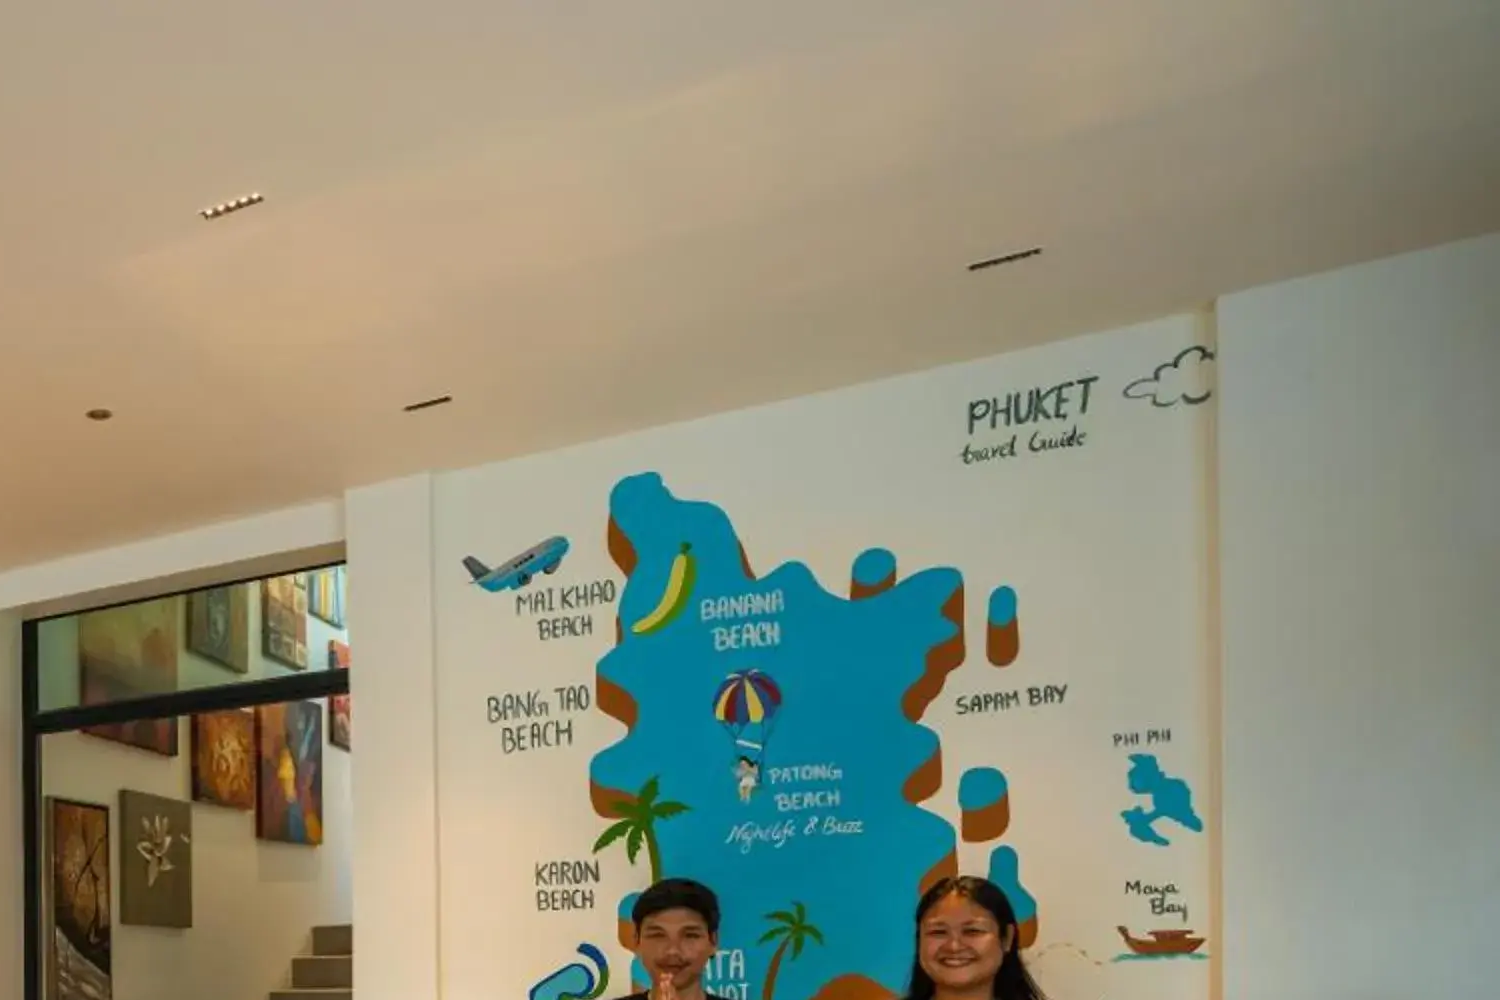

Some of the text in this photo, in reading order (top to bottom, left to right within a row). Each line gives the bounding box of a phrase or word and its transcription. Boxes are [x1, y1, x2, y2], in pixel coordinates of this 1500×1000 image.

[968, 376, 1099, 435] PHUKET
[516, 579, 617, 616] MAI KHAO
[700, 588, 785, 622] BANANA
[537, 614, 593, 641] BEACH
[710, 620, 781, 651] BEACH
[486, 684, 590, 724] BANG TAO
[955, 684, 1069, 715] SAPAM BAY
[501, 719, 573, 754] BEACH
[773, 788, 841, 812] BEACH
[534, 860, 601, 887] KARON
[535, 889, 596, 912] BEACH
[1149, 897, 1189, 923] Bay
